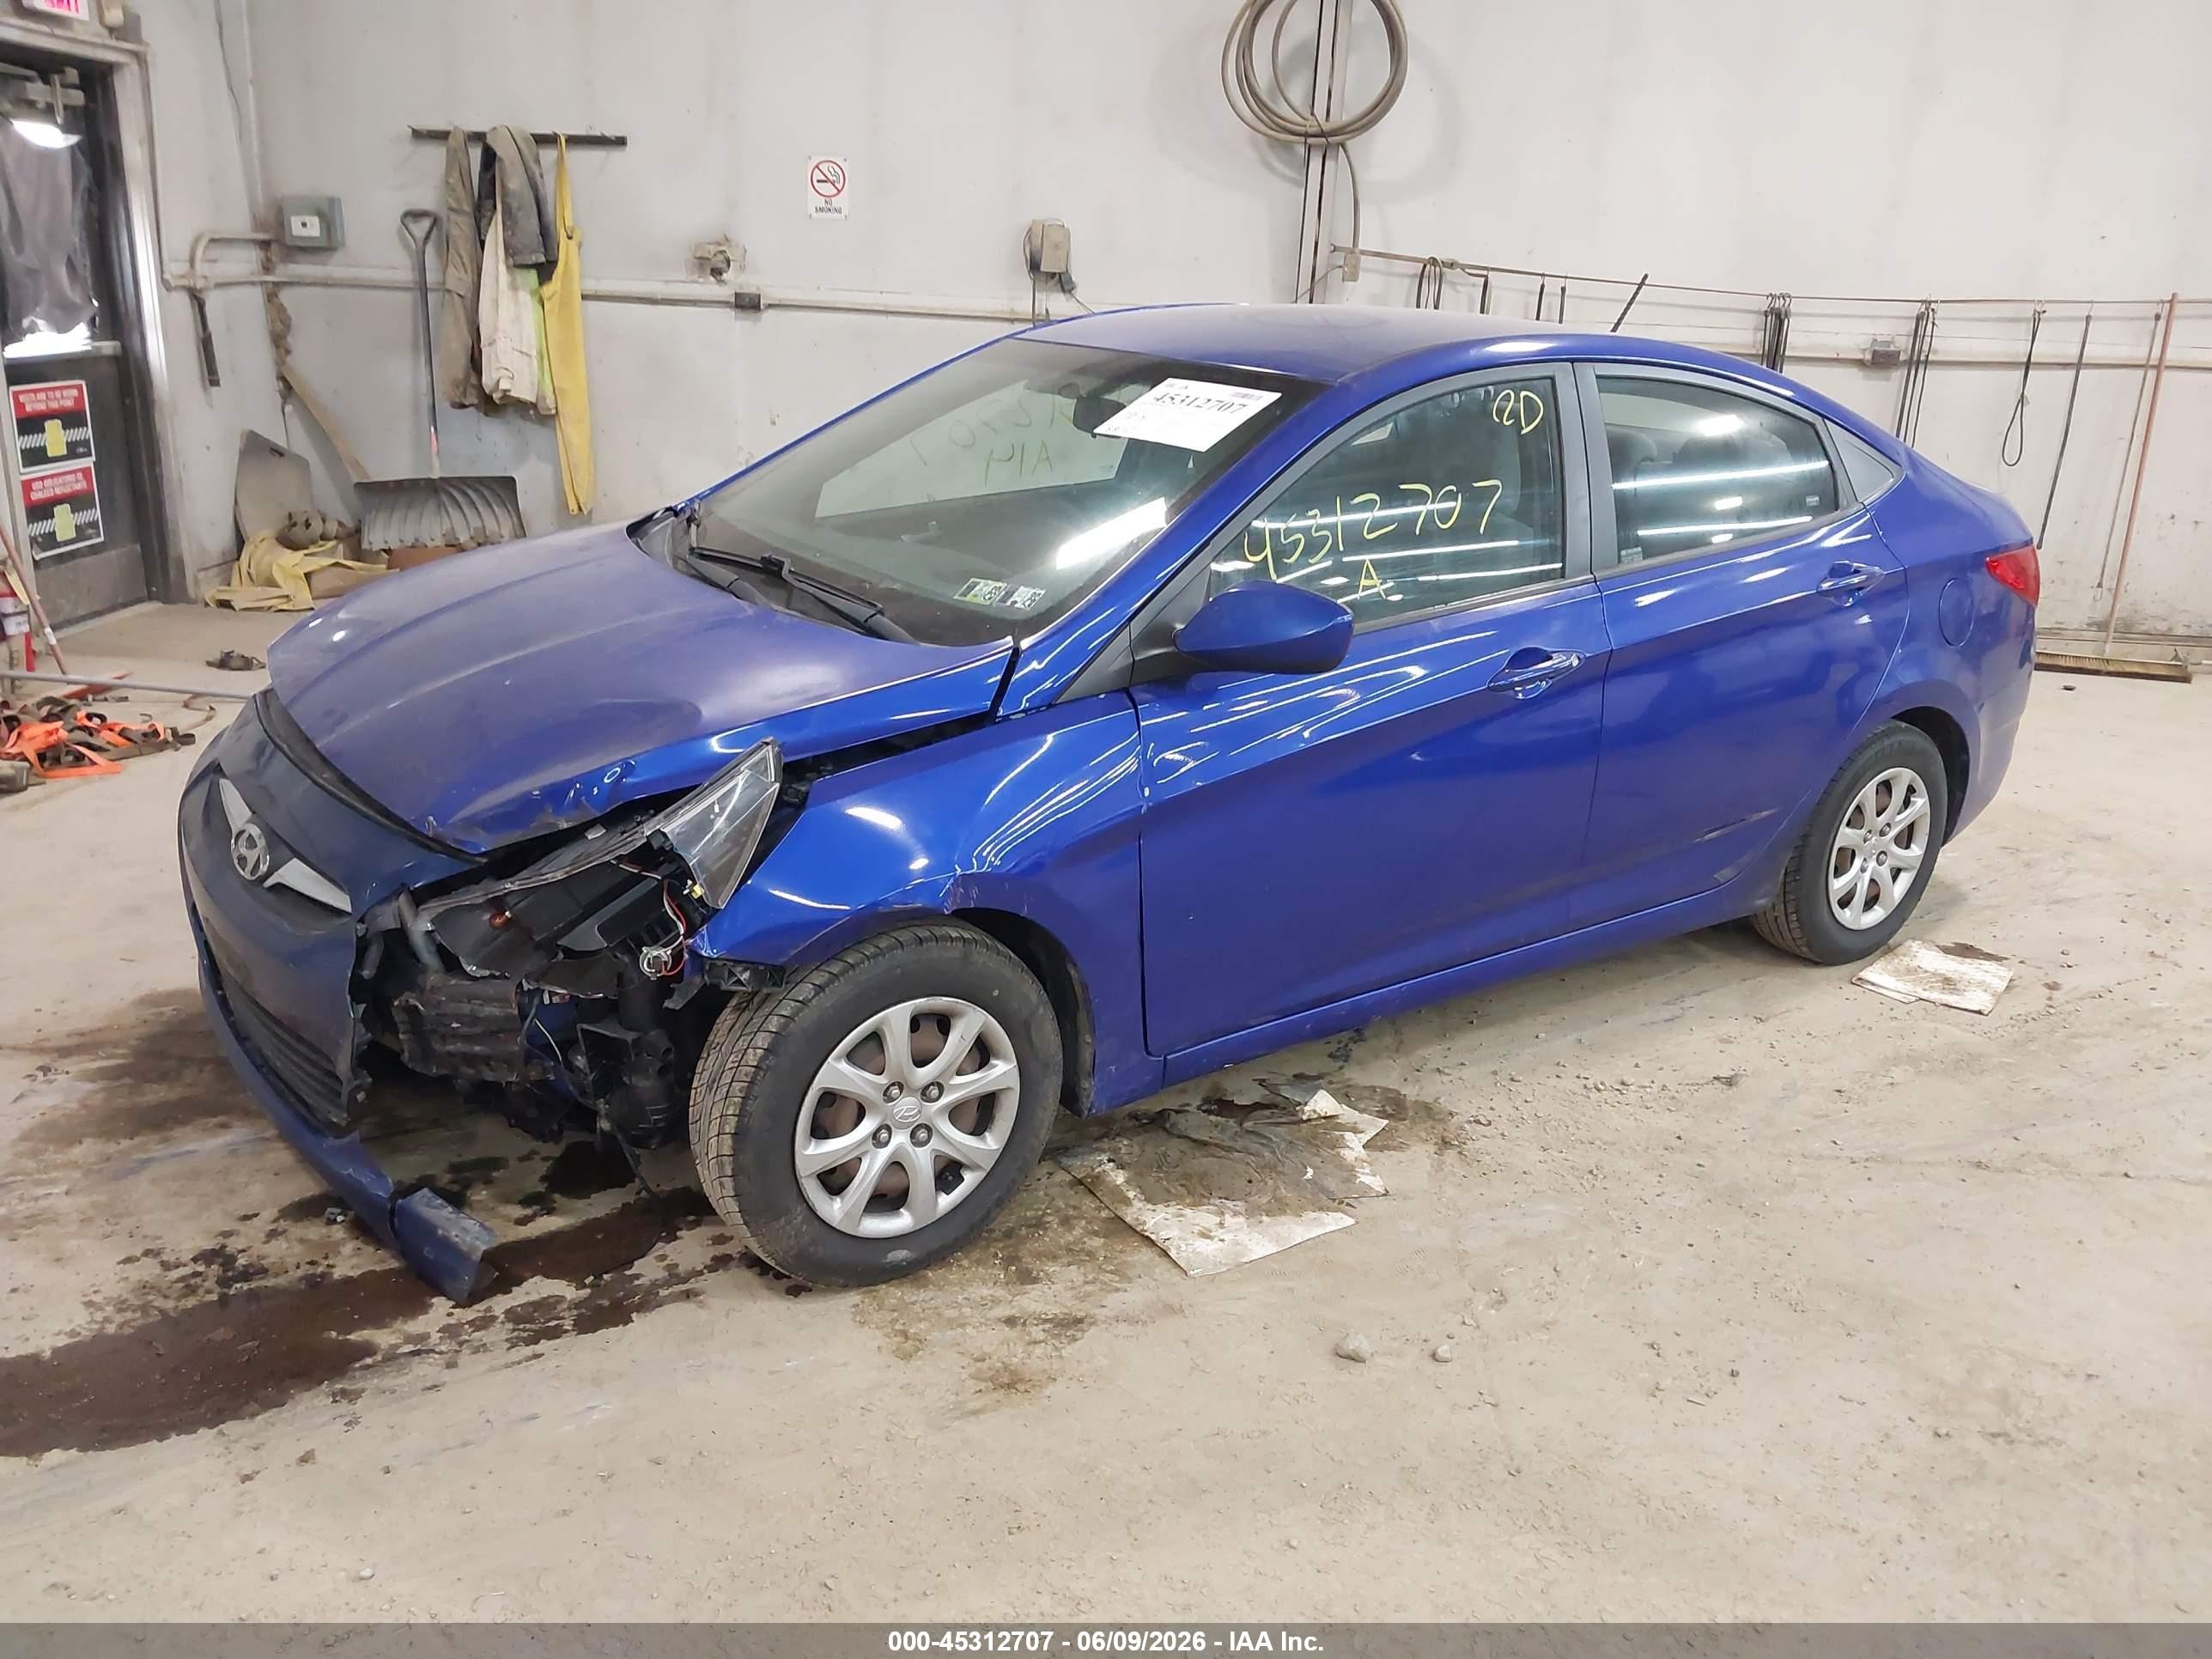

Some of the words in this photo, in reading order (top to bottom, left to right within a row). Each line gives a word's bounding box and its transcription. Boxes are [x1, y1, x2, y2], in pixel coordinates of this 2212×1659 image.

[1154, 392, 1250, 415] 45312707
[1243, 478, 1504, 581] 45312707
[1357, 558, 1389, 600] A
